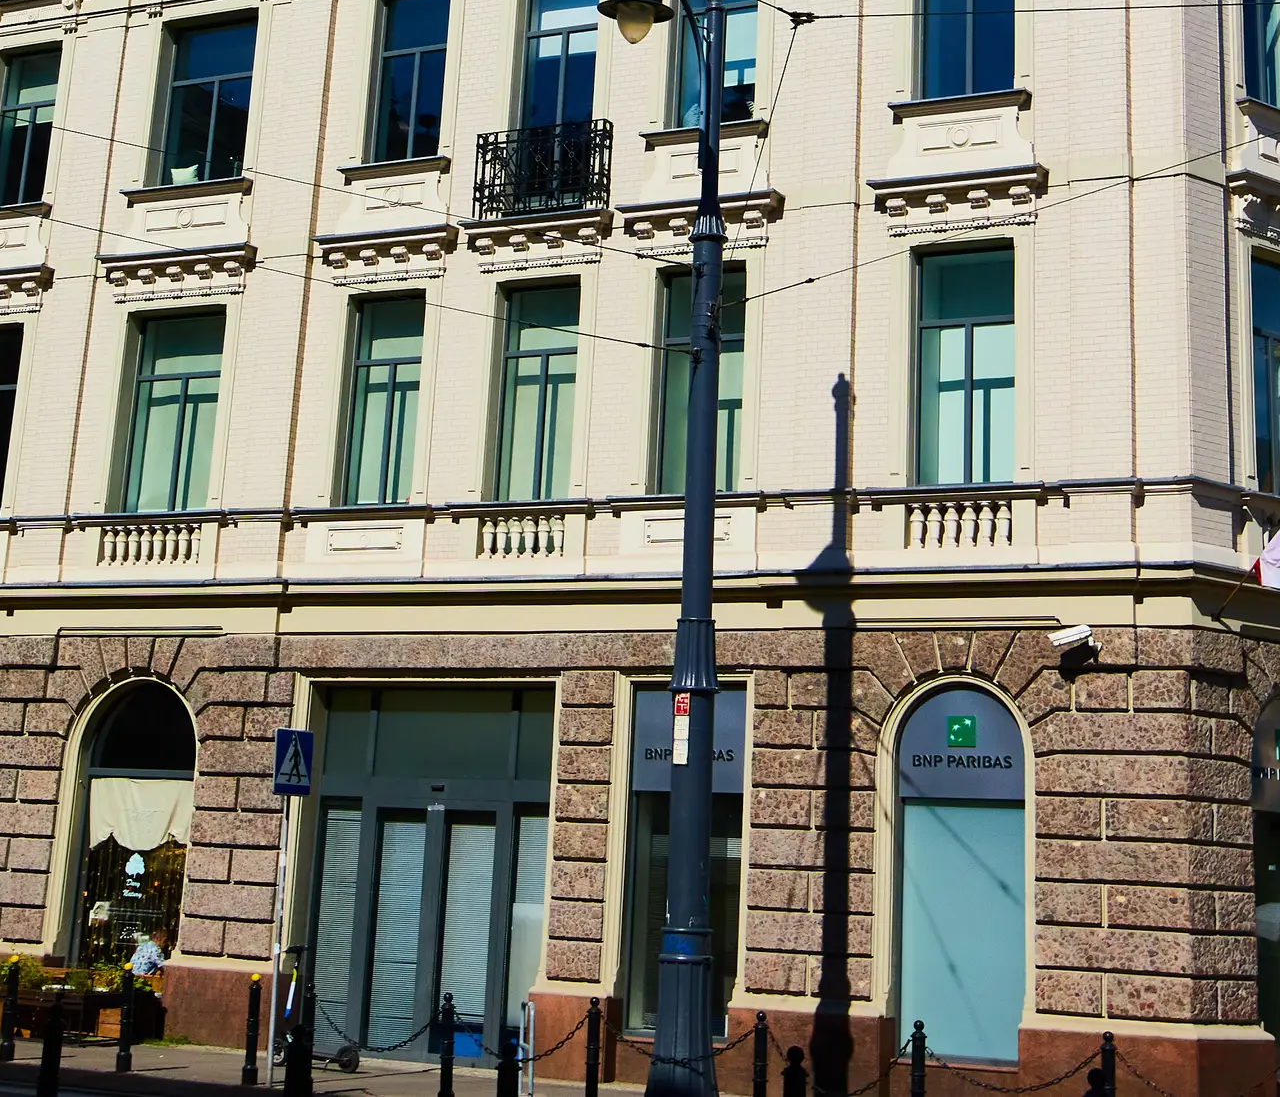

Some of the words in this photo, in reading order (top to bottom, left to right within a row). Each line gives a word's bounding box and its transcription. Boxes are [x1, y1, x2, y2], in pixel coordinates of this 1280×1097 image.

[644, 748, 672, 760] BNP
[912, 754, 943, 768] BNP
[947, 755, 1013, 769] PARIBAS
